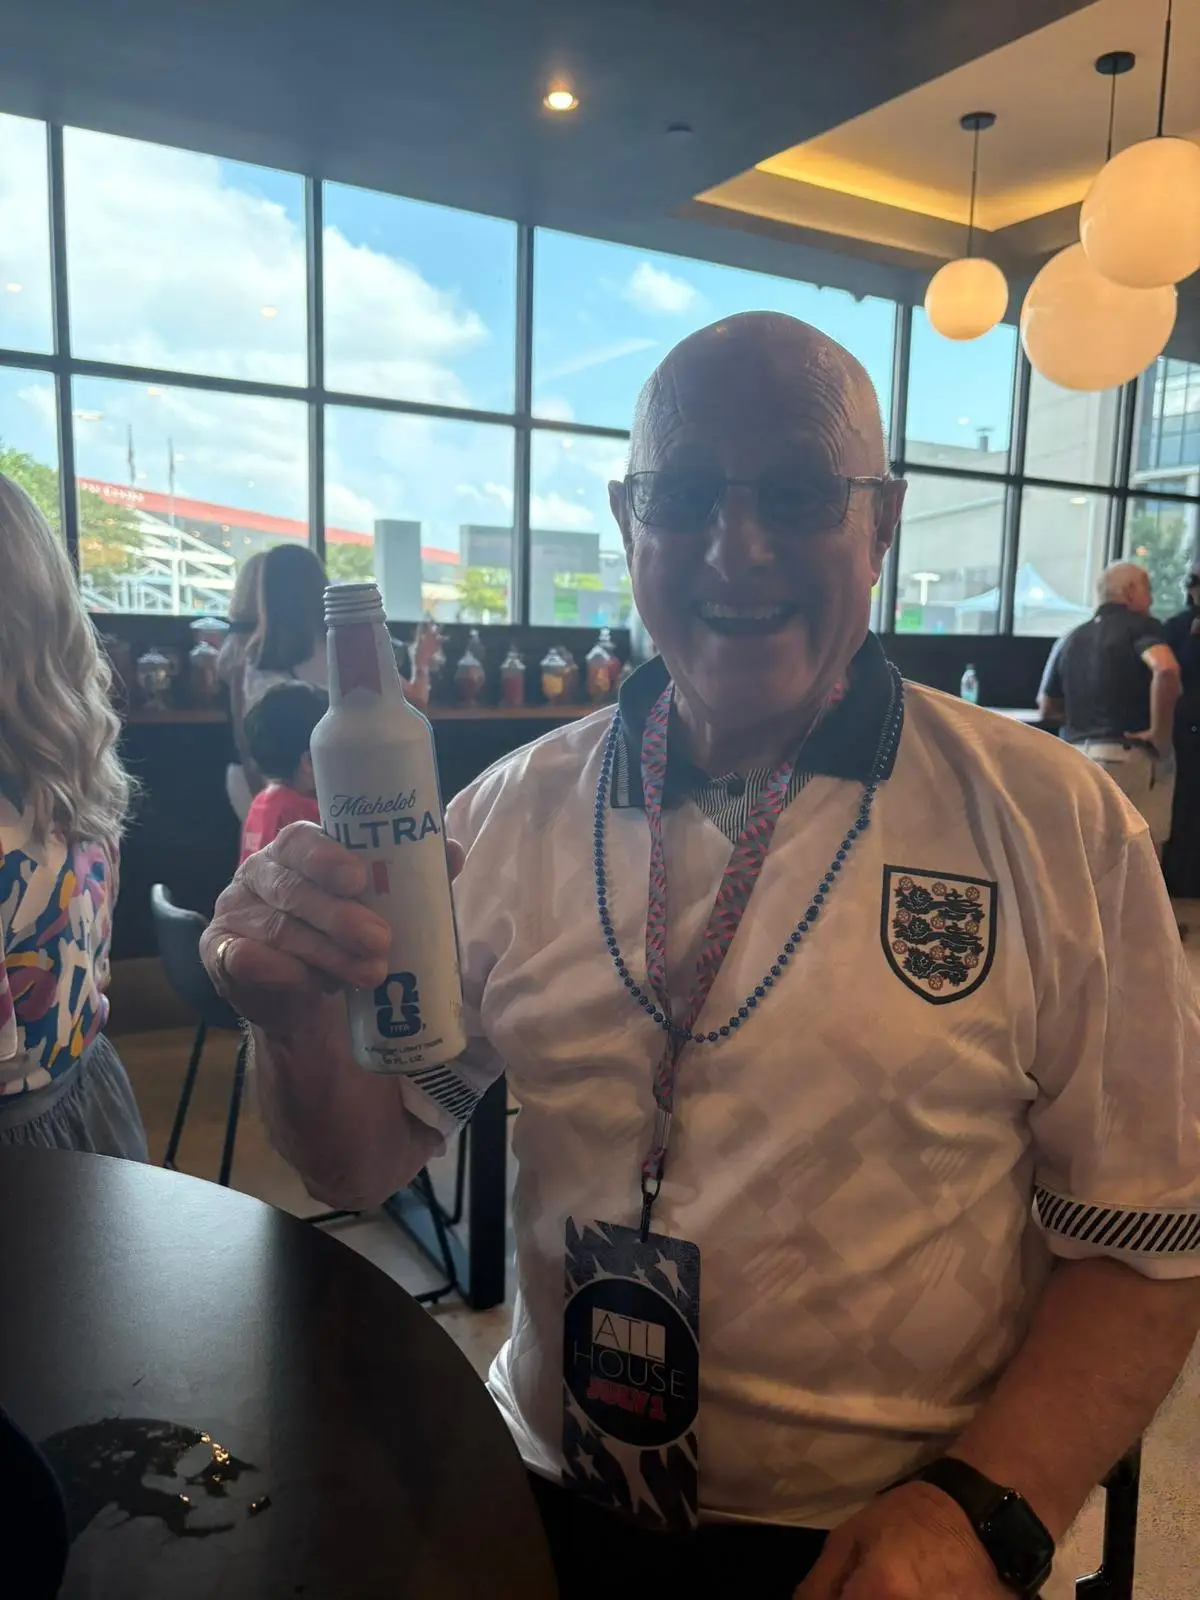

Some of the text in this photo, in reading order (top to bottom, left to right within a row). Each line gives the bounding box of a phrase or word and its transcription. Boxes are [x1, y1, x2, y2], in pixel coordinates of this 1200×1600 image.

[330, 789, 416, 817] Michelob
[323, 811, 438, 849] ULTRA
[594, 1313, 664, 1360] ATL
[573, 1341, 685, 1398] HOUSE
